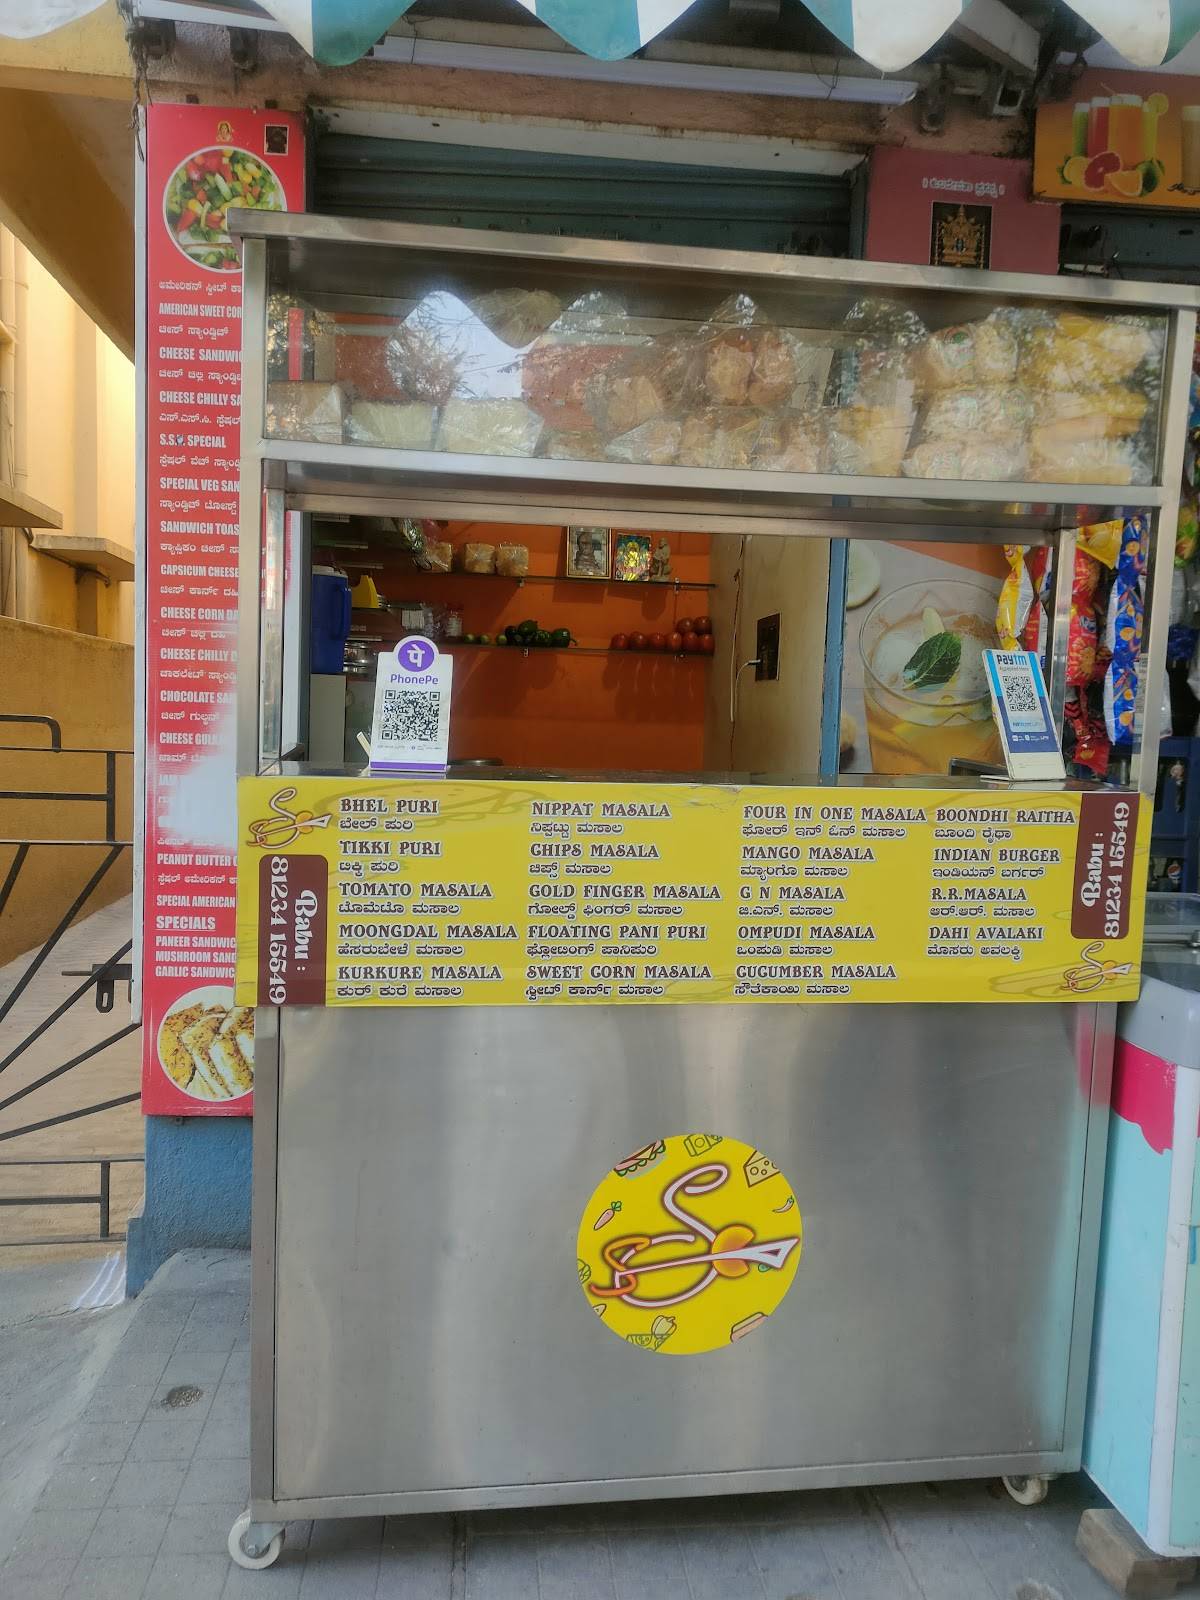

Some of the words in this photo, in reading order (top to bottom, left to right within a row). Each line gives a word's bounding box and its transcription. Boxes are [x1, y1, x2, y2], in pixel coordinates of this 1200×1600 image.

[159, 303, 198, 316] AMERICAN
[200, 305, 225, 317] SWEET
[160, 347, 194, 360] CHEESE
[160, 391, 194, 403] CHEESE
[197, 392, 228, 406] CHILLY
[188, 436, 226, 448] SPECIAL
[160, 478, 198, 490] SPECIAL
[201, 479, 219, 491] VEG
[161, 521, 213, 534] SANDWICH
[161, 565, 206, 576] CAPSICUM
[208, 567, 240, 577] CHEESE
[161, 607, 196, 619] CHEESE
[198, 608, 224, 620] CORN
[160, 648, 195, 660] CHEESE
[198, 649, 228, 662] CHILLY
[390, 674, 438, 684] PhonePe
[160, 690, 215, 703] CHOCOLATE
[160, 732, 193, 744] CHEESE
[341, 799, 387, 813] BHEL
[397, 800, 438, 813] PURI
[532, 802, 593, 816] NIPPAT
[602, 803, 670, 817] MASALA
[744, 806, 786, 819] FOUR
[794, 807, 812, 819] IN
[821, 807, 853, 820] ONE
[861, 808, 926, 821] MASALA
[937, 809, 1008, 822] BOONDHI
[1017, 810, 1075, 823] RAITHA
[385, 819, 412, 830] ಪುರಿ
[577, 823, 623, 833] ಮಸಾಲ
[863, 827, 906, 837] ಮಸಾಲ
[1109, 802, 1130, 869] 15549
[340, 841, 389, 854] TIKKI
[400, 842, 440, 855] PURI
[531, 844, 582, 857] CHIPS
[591, 845, 659, 857] MASALA
[742, 847, 800, 859] MANGO
[809, 848, 874, 860] MASALA
[157, 853, 193, 865] PEANUT
[195, 855, 230, 866] BUTTER
[934, 849, 990, 861] INDIAN
[999, 850, 1060, 862] BURGER
[371, 861, 398, 871] ಪುರಿ
[566, 864, 611, 874] ಮಸಾಲ
[805, 867, 848, 876] ಮಸಾಲ
[270, 856, 289, 926] 81234
[339, 883, 411, 896] TOMATO
[421, 884, 492, 897] MASALA
[529, 885, 574, 897] GOLD
[584, 885, 645, 898] FINGER
[653, 886, 720, 898] MASALA
[740, 887, 751, 898] G
[760, 887, 770, 899] N
[779, 887, 845, 899] MASALA
[157, 895, 190, 906] SPECIAL
[192, 896, 235, 907] AMERICAN
[1104, 874, 1123, 938] 81234
[412, 903, 460, 913] ಮಸಾಲ
[638, 905, 682, 915] ಮಸಾಲ
[790, 906, 832, 915] ಮಸಾಲ
[994, 906, 1035, 916] ಮಸಾಲ
[156, 916, 215, 929] SPECIALS
[340, 924, 437, 938] MOONGDAL
[447, 925, 517, 938] MASALA
[528, 925, 611, 938] FLOATING
[619, 926, 658, 938] PANI
[667, 926, 706, 938] PURI
[738, 927, 800, 939] OMPUDI
[810, 927, 874, 939] MASALA
[929, 927, 968, 939] DAHI
[976, 927, 1043, 939] AVALAKI
[156, 936, 190, 946] PANEER
[155, 951, 210, 962] MUSHROOM
[416, 945, 462, 955] ಮಸಾಲ
[790, 946, 832, 955] ಮಸಾಲ
[155, 966, 188, 977] GARLIC
[269, 933, 287, 1005] 15549
[339, 966, 421, 979] KURKURE
[432, 966, 501, 979] MASALA
[527, 965, 582, 978] SWEET
[591, 966, 635, 978] CORN
[644, 966, 711, 979] MASALA
[736, 966, 823, 978] CUCUMBER
[832, 966, 896, 978] MASALA
[415, 986, 462, 996] ಮಸಾಲ
[619, 985, 664, 995] ಮಸಾಲ
[807, 984, 849, 994] ಮಸಾಲ
